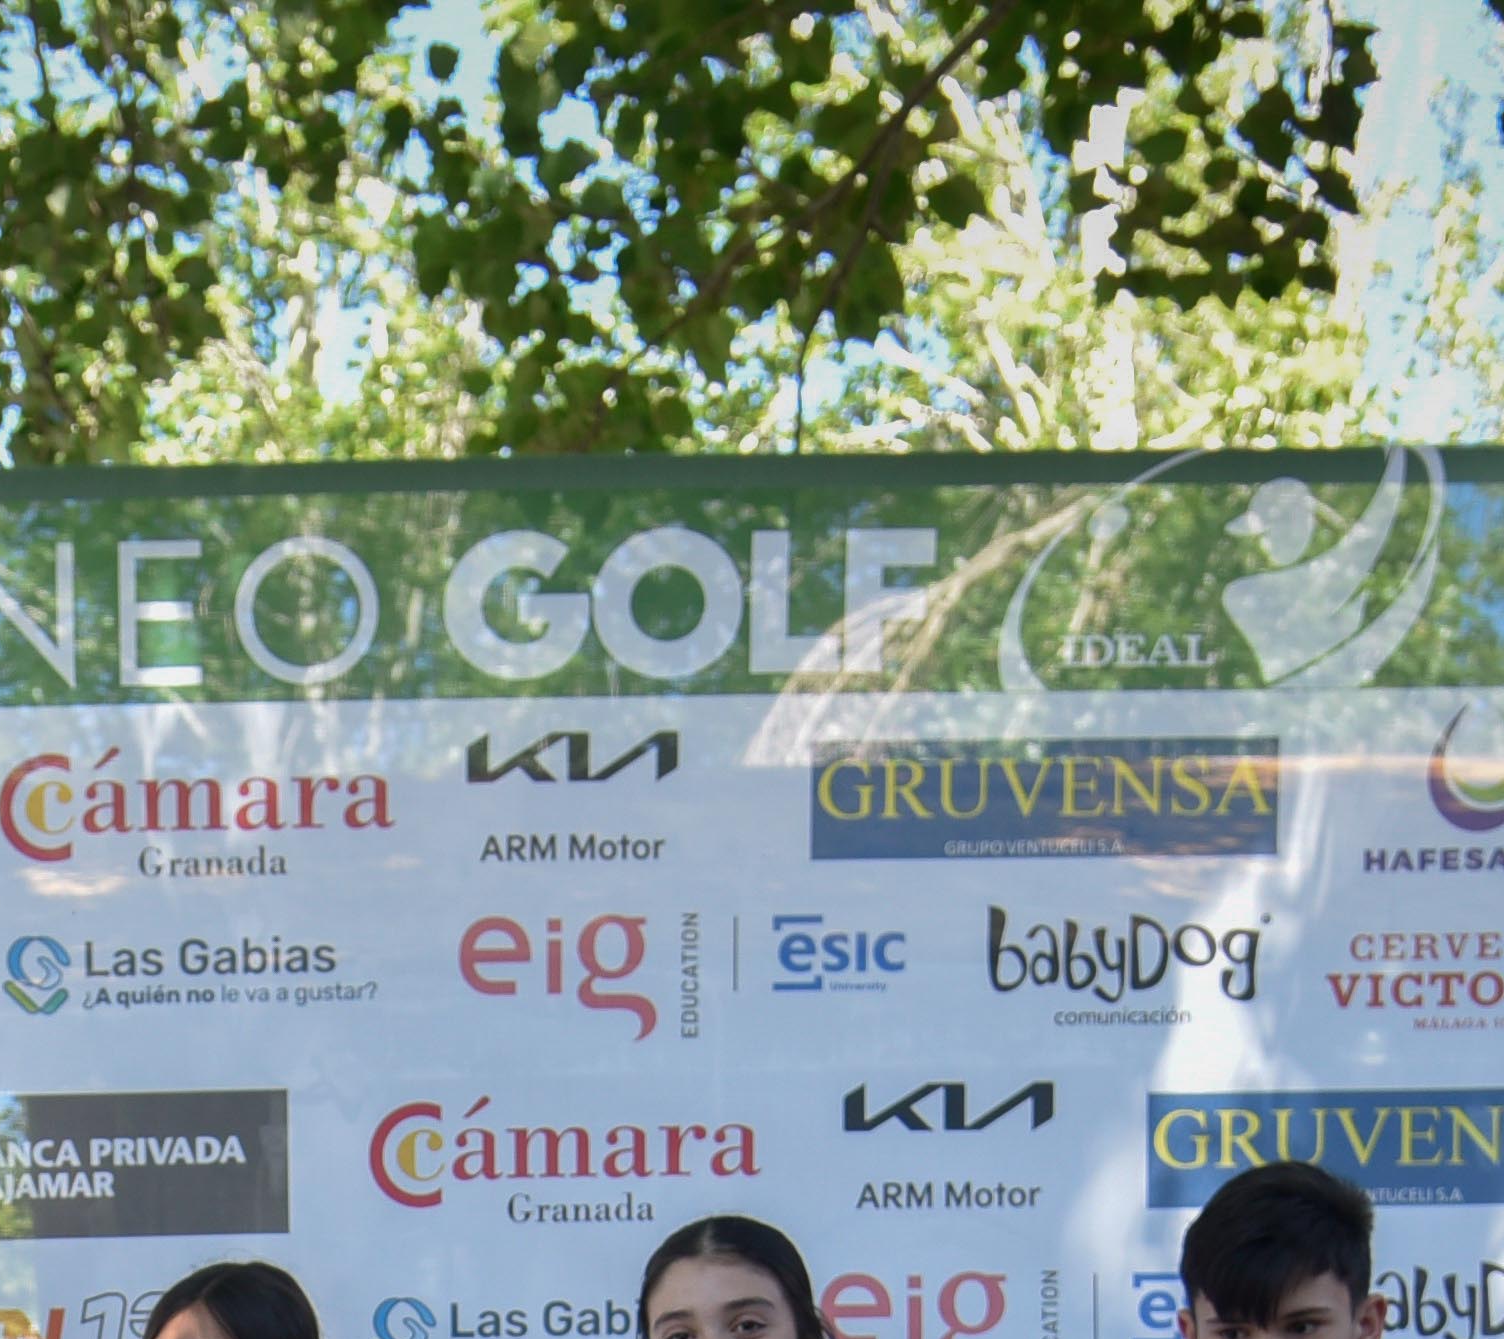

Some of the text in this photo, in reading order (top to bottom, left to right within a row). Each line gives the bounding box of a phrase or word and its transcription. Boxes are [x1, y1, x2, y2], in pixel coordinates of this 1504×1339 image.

[442, 525, 937, 681] GOLF
[1061, 632, 1217, 671] IDEAL
[465, 729, 680, 785] KIA
[815, 755, 1271, 822] GRUVENSA
[137, 845, 288, 878] Granada
[478, 831, 666, 864] ARM Motor
[943, 841, 1006, 857] GRUPO
[84, 936, 337, 977] Las Gabias
[457, 913, 659, 1043] eig
[679, 911, 700, 1040] EDUCATION
[82, 980, 379, 1009] ¿A quién no le va a gustar?
[1052, 1007, 1192, 1028] comunicación
[842, 1080, 1054, 1132] KIA
[90, 1134, 246, 1166] PRIVADA
[507, 1192, 655, 1223] Granada
[855, 1181, 1041, 1209] ARM Motor
[1363, 1186, 1432, 1203] NTUCELI
[448, 1301, 528, 1339] Las
